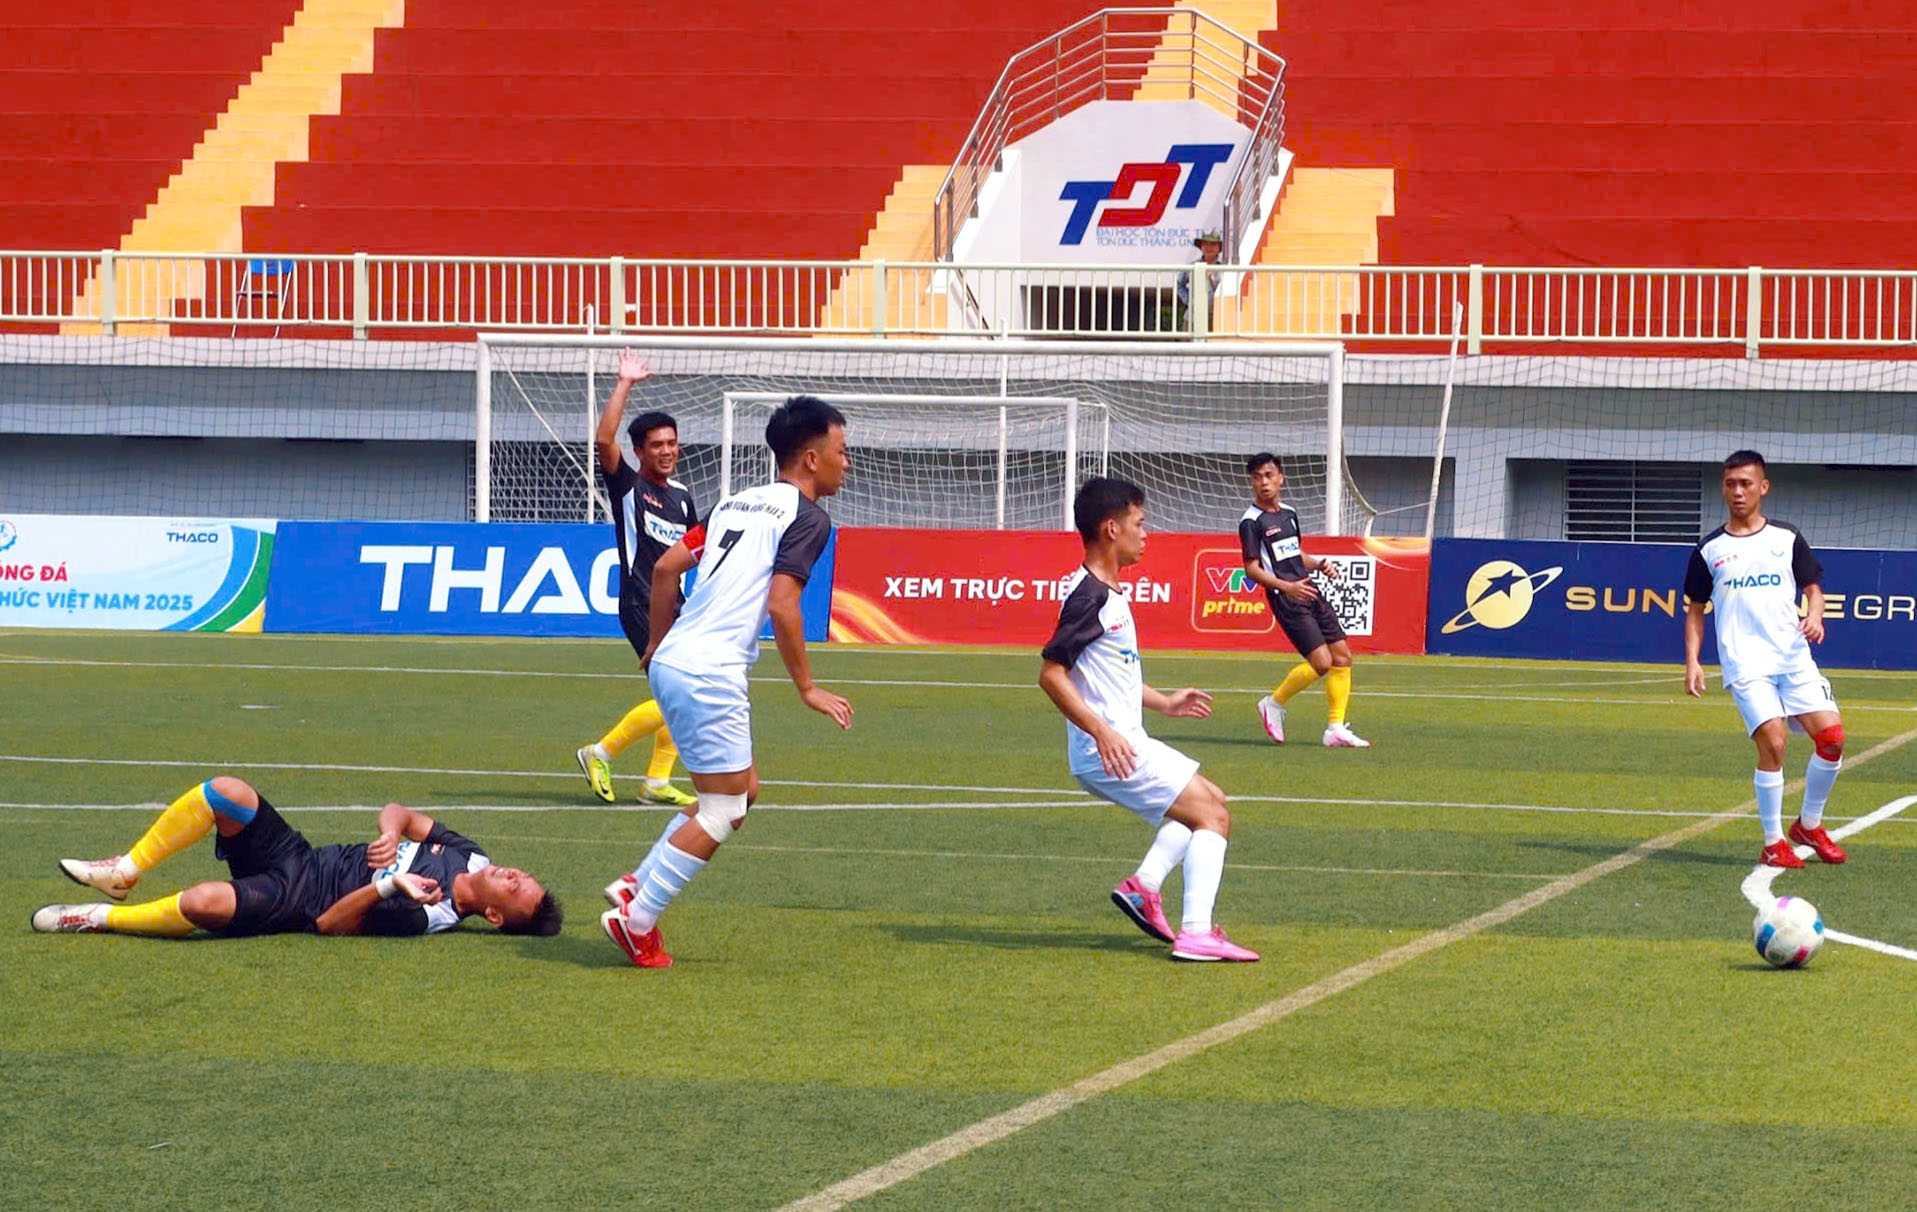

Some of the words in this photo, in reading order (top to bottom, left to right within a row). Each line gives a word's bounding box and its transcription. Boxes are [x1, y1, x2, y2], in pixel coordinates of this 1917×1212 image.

[166, 532, 219, 543] THACO
[707, 529, 745, 580] 7
[0, 561, 35, 581] NG
[40, 561, 68, 582] ĐÁ
[359, 545, 621, 615] THA
[1205, 568, 1258, 593] VTV
[1723, 574, 1781, 589] THACO
[0, 587, 40, 608] HỨC
[46, 588, 90, 614] VIỆT
[94, 593, 140, 609] NAM
[144, 594, 194, 610] 2025
[884, 576, 943, 598] XEM
[950, 576, 1025, 606] TRỰC
[1031, 572, 1077, 600] TIẾ
[1118, 577, 1170, 603] RÊN
[1202, 597, 1266, 618] prime
[1853, 594, 1917, 621] GR
